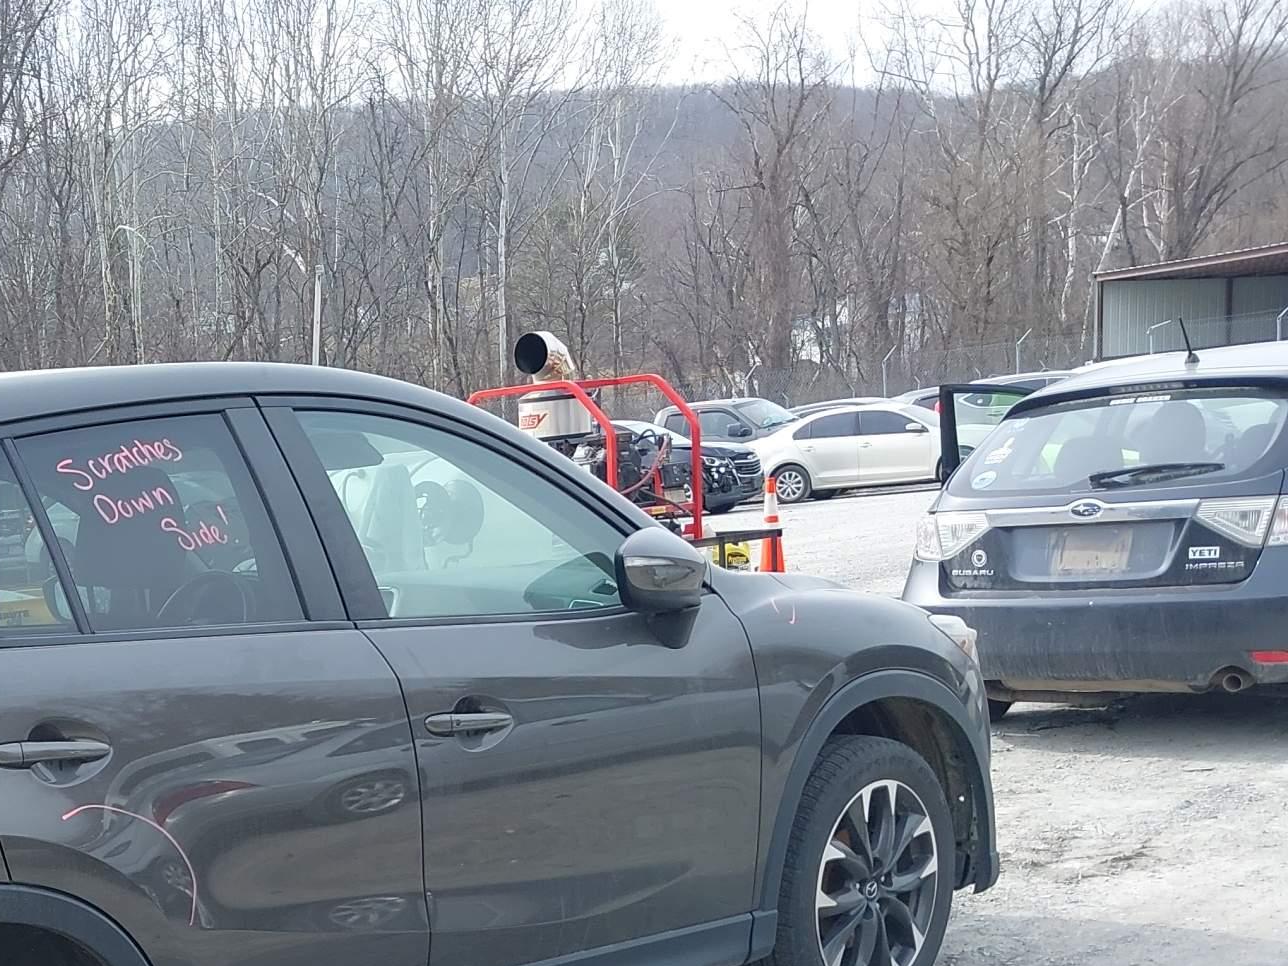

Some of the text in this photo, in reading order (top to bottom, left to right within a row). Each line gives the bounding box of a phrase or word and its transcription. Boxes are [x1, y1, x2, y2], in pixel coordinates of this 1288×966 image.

[57, 439, 182, 490] Scratches
[94, 487, 174, 524] Down
[161, 506, 239, 550] Side!
[1185, 561, 1245, 570] IMPREZA
[1190, 548, 1219, 558] YETI
